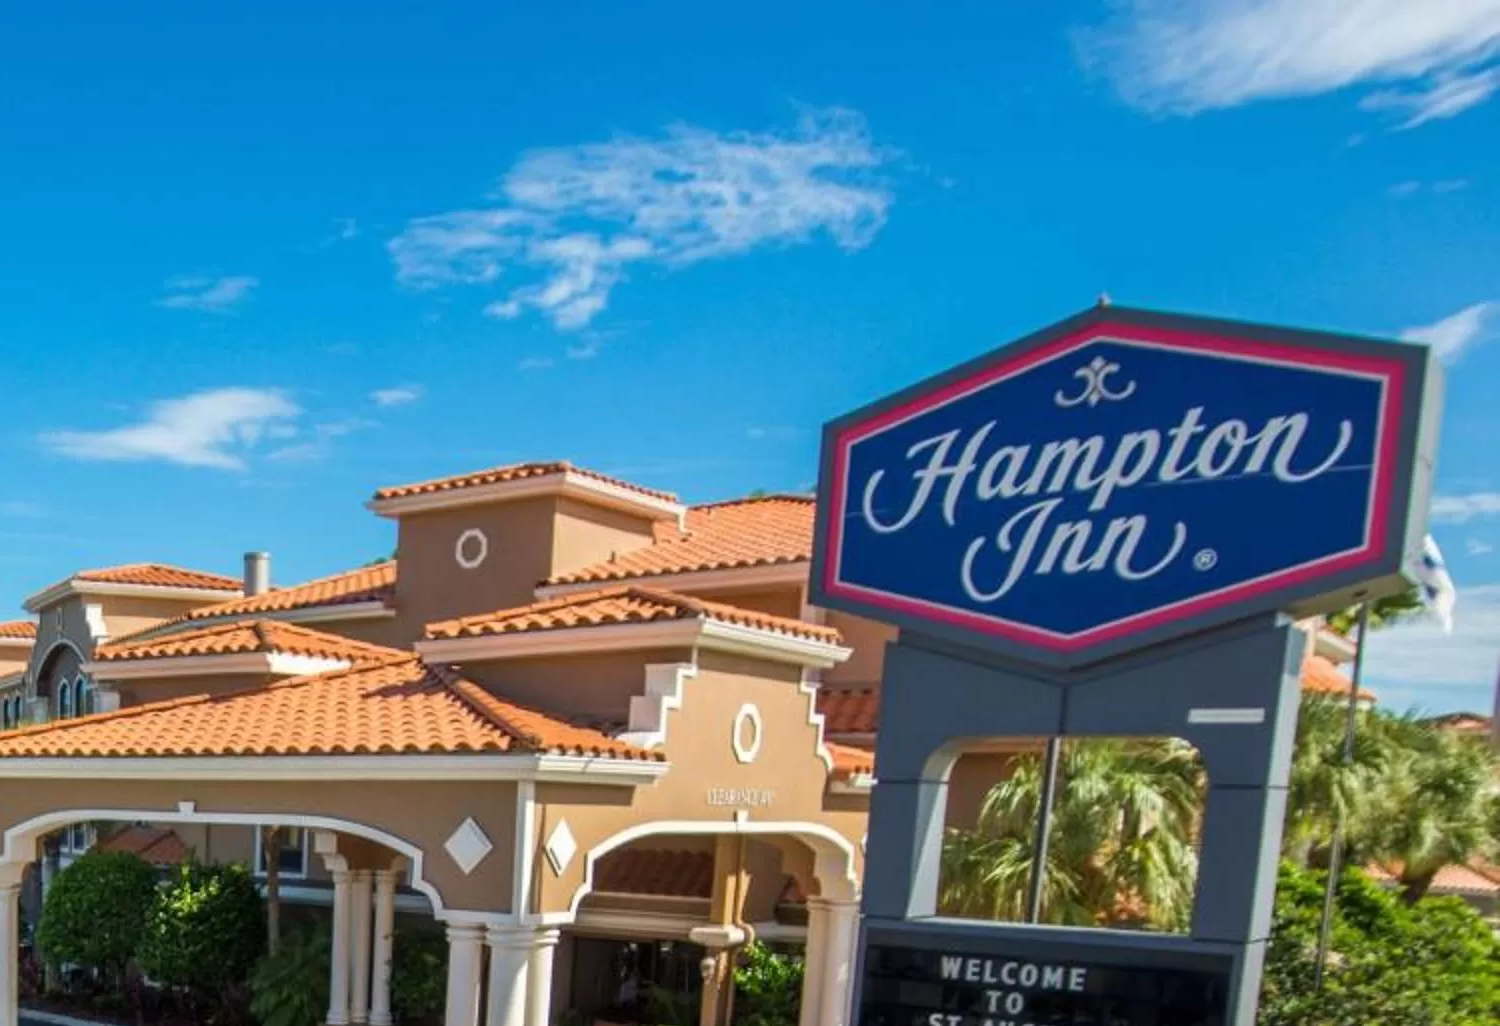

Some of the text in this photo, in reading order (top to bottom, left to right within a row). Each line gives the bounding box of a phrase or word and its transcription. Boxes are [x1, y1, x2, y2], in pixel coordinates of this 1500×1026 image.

[863, 406, 1352, 533] Hampton
[961, 499, 1186, 602] Inn
[940, 956, 1087, 991] WELCOME
[986, 991, 1025, 1015] TO
